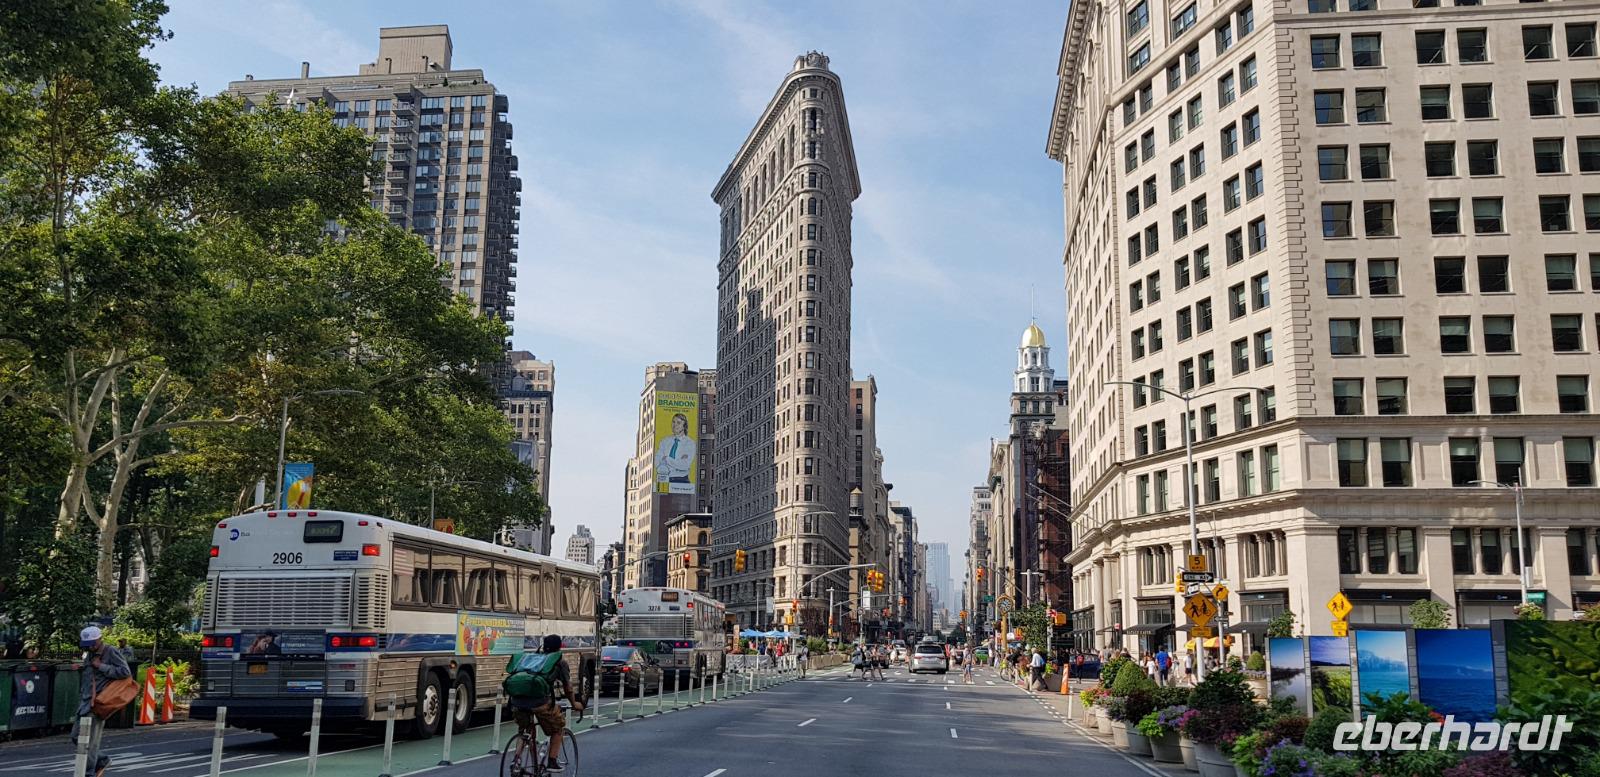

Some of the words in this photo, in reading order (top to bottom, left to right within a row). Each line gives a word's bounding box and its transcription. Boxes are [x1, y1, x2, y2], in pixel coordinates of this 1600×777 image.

[658, 399, 696, 408] BRANDON
[273, 552, 303, 564] 2906
[1194, 556, 1200, 565] 5
[15, 705, 46, 715] RECYCLING
